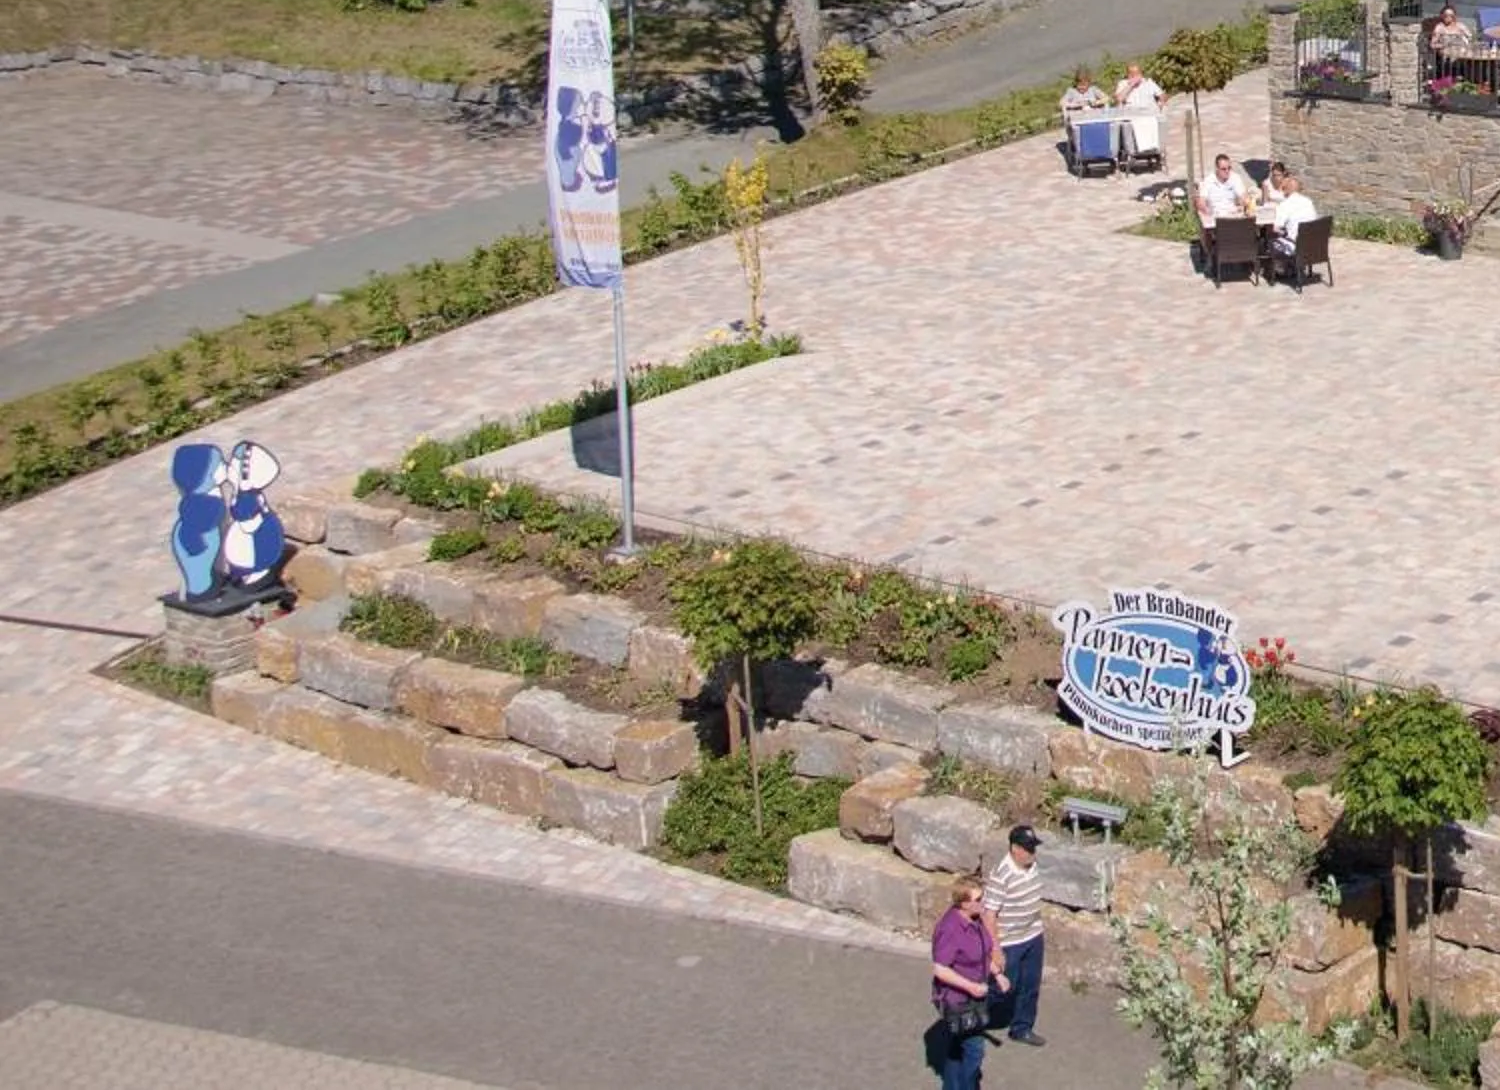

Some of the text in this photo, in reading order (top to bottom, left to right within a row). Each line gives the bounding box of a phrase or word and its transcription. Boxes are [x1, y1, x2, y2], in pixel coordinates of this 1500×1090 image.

[1058, 608, 1192, 667] Pannen-
[1113, 591, 1233, 634] Der Brabander
[1094, 657, 1248, 725] koekenhuis
